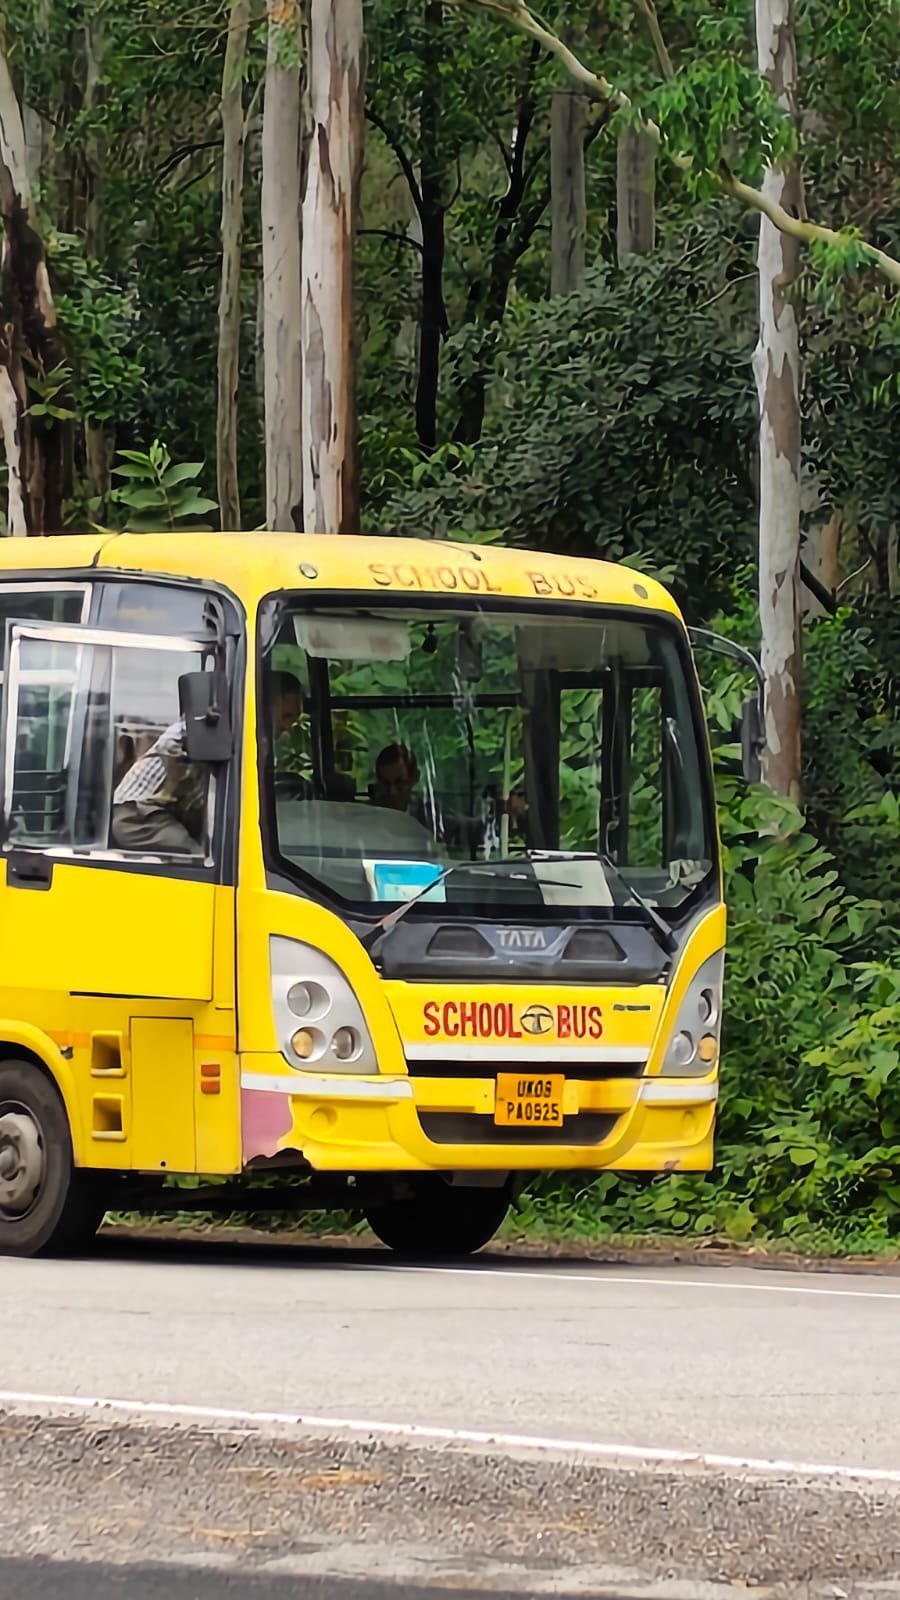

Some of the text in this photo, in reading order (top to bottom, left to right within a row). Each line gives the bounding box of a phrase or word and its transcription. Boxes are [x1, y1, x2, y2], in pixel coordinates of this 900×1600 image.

[368, 563, 599, 598] SCHOOL BUS
[496, 930, 546, 948] TATA
[423, 1001, 603, 1039] SCHOOL BUS
